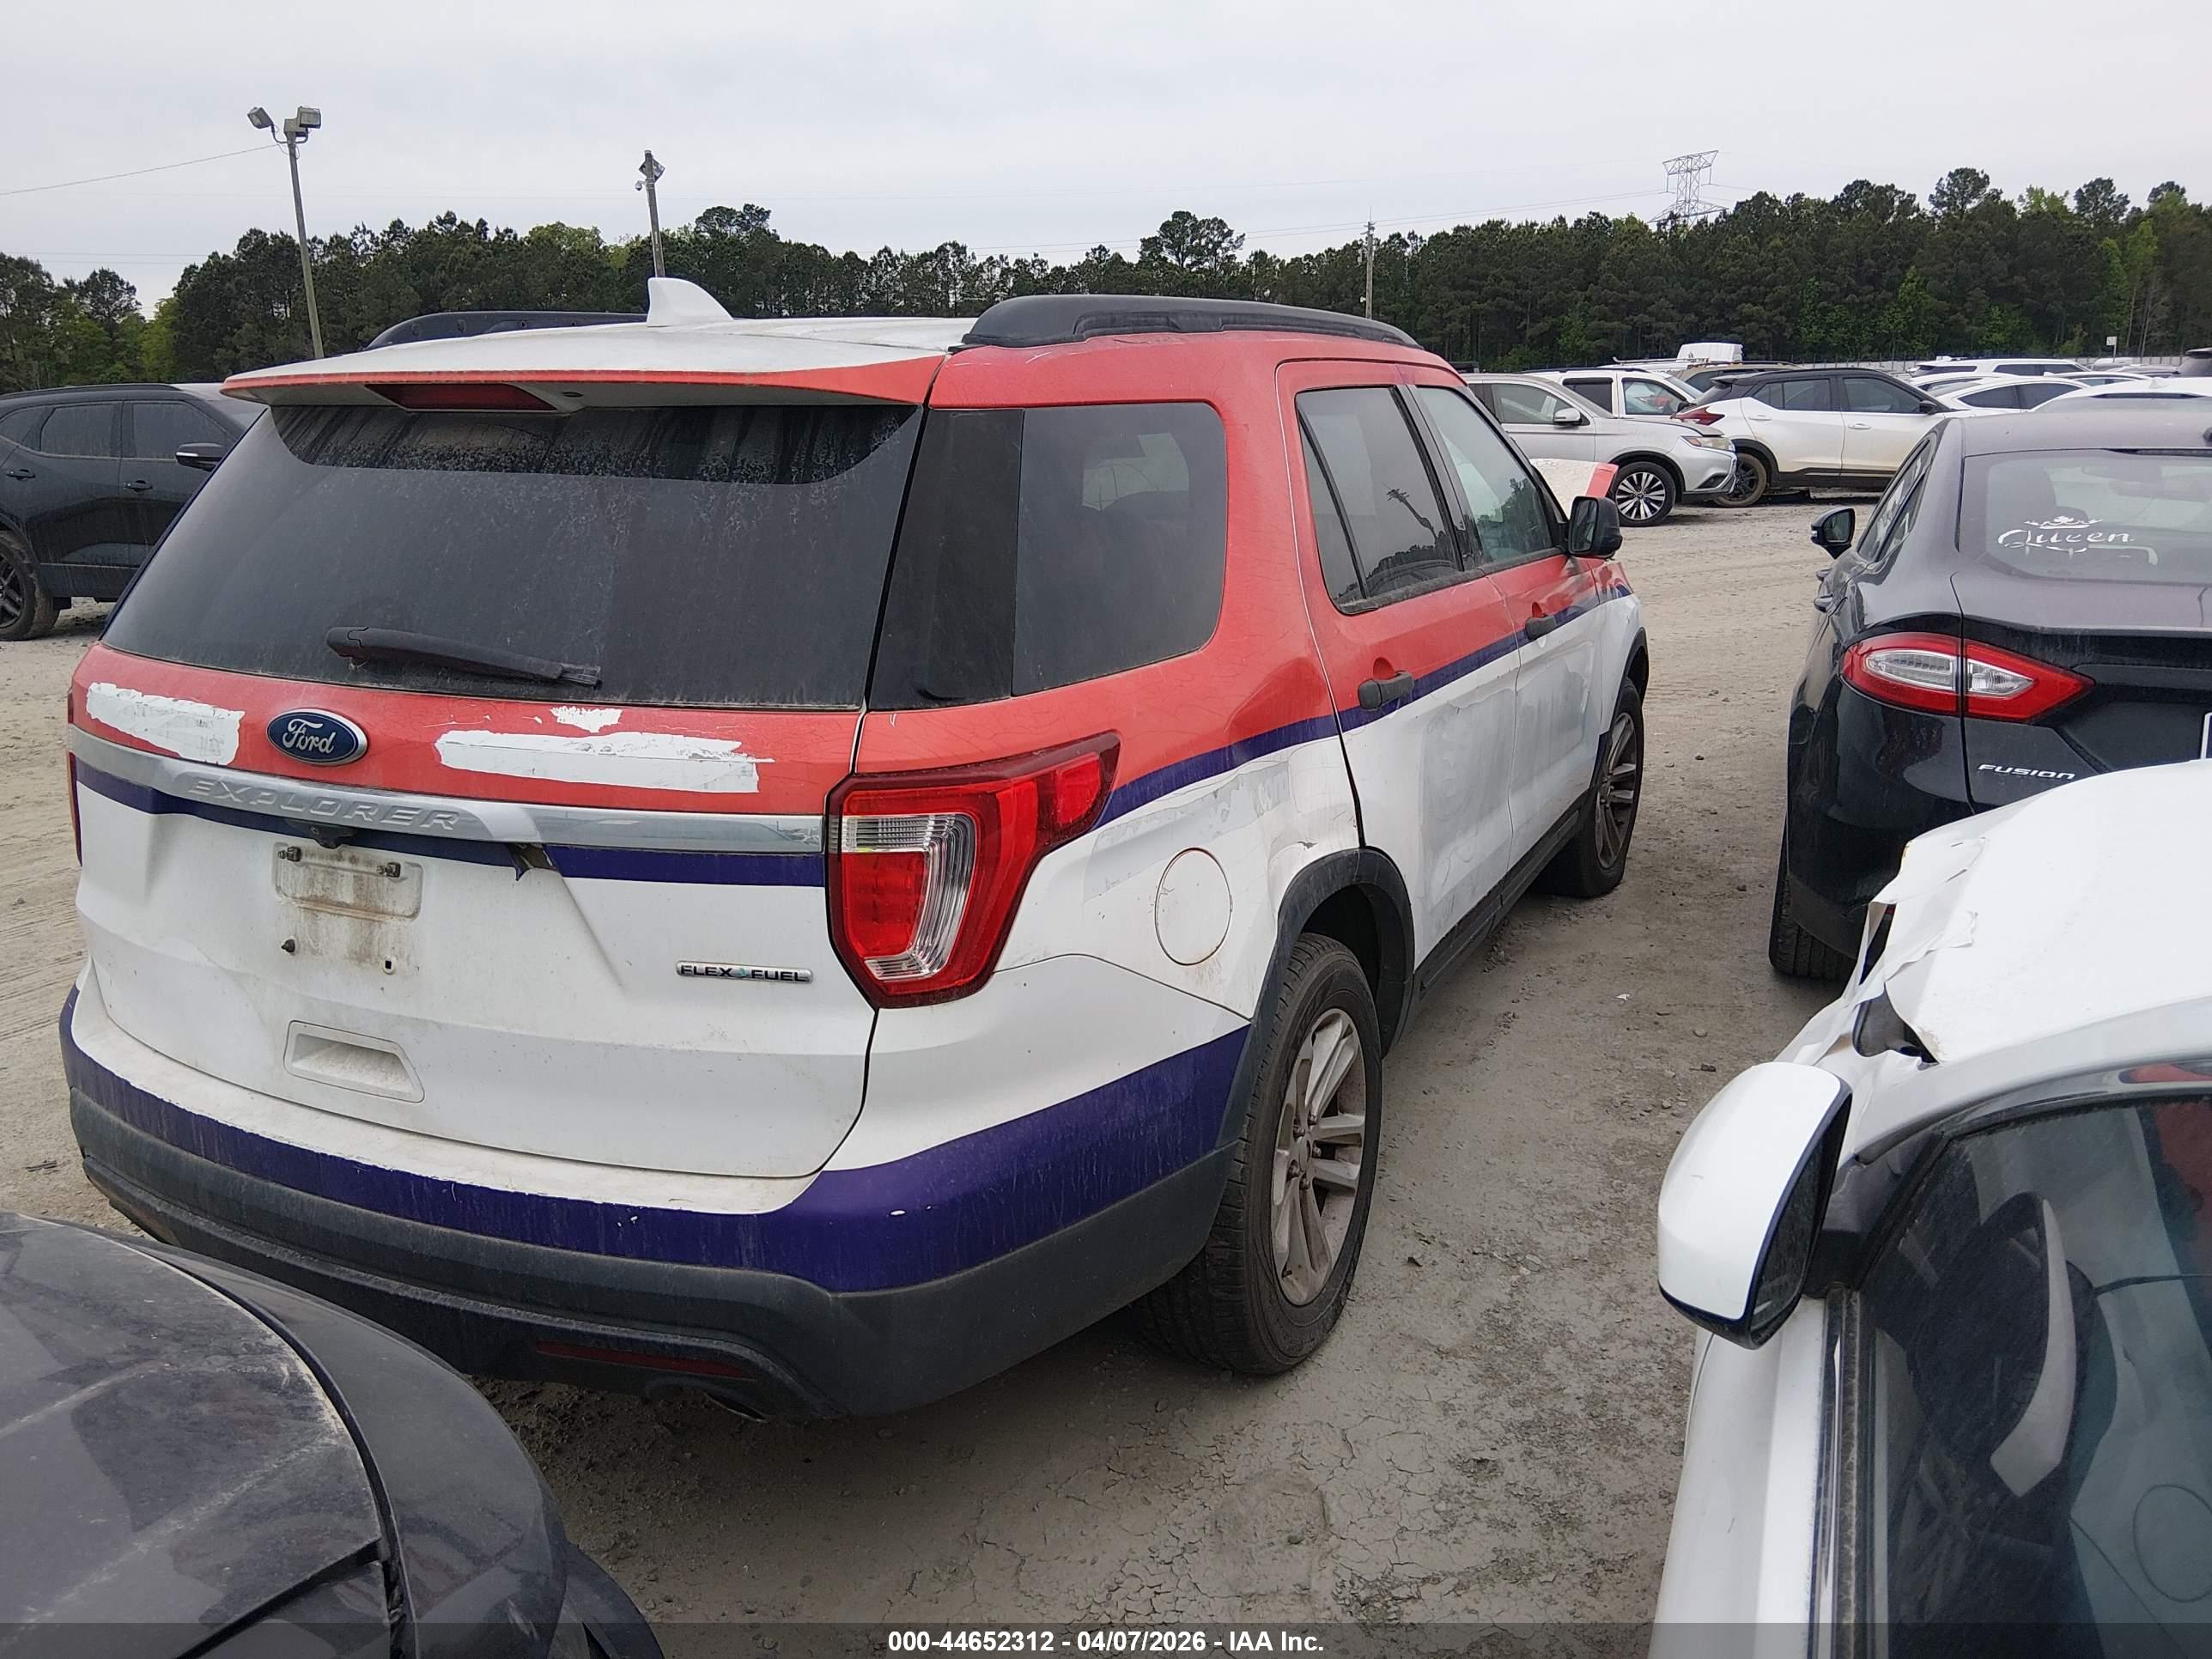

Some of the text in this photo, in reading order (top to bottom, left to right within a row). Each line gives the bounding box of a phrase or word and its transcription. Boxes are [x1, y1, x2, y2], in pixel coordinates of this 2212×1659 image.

[1997, 529, 2136, 550] Queen
[282, 718, 337, 755] Ford
[1978, 763, 2076, 781] FUSION
[187, 777, 460, 831] EXPLORER
[680, 963, 810, 983] FLEX FUEL
